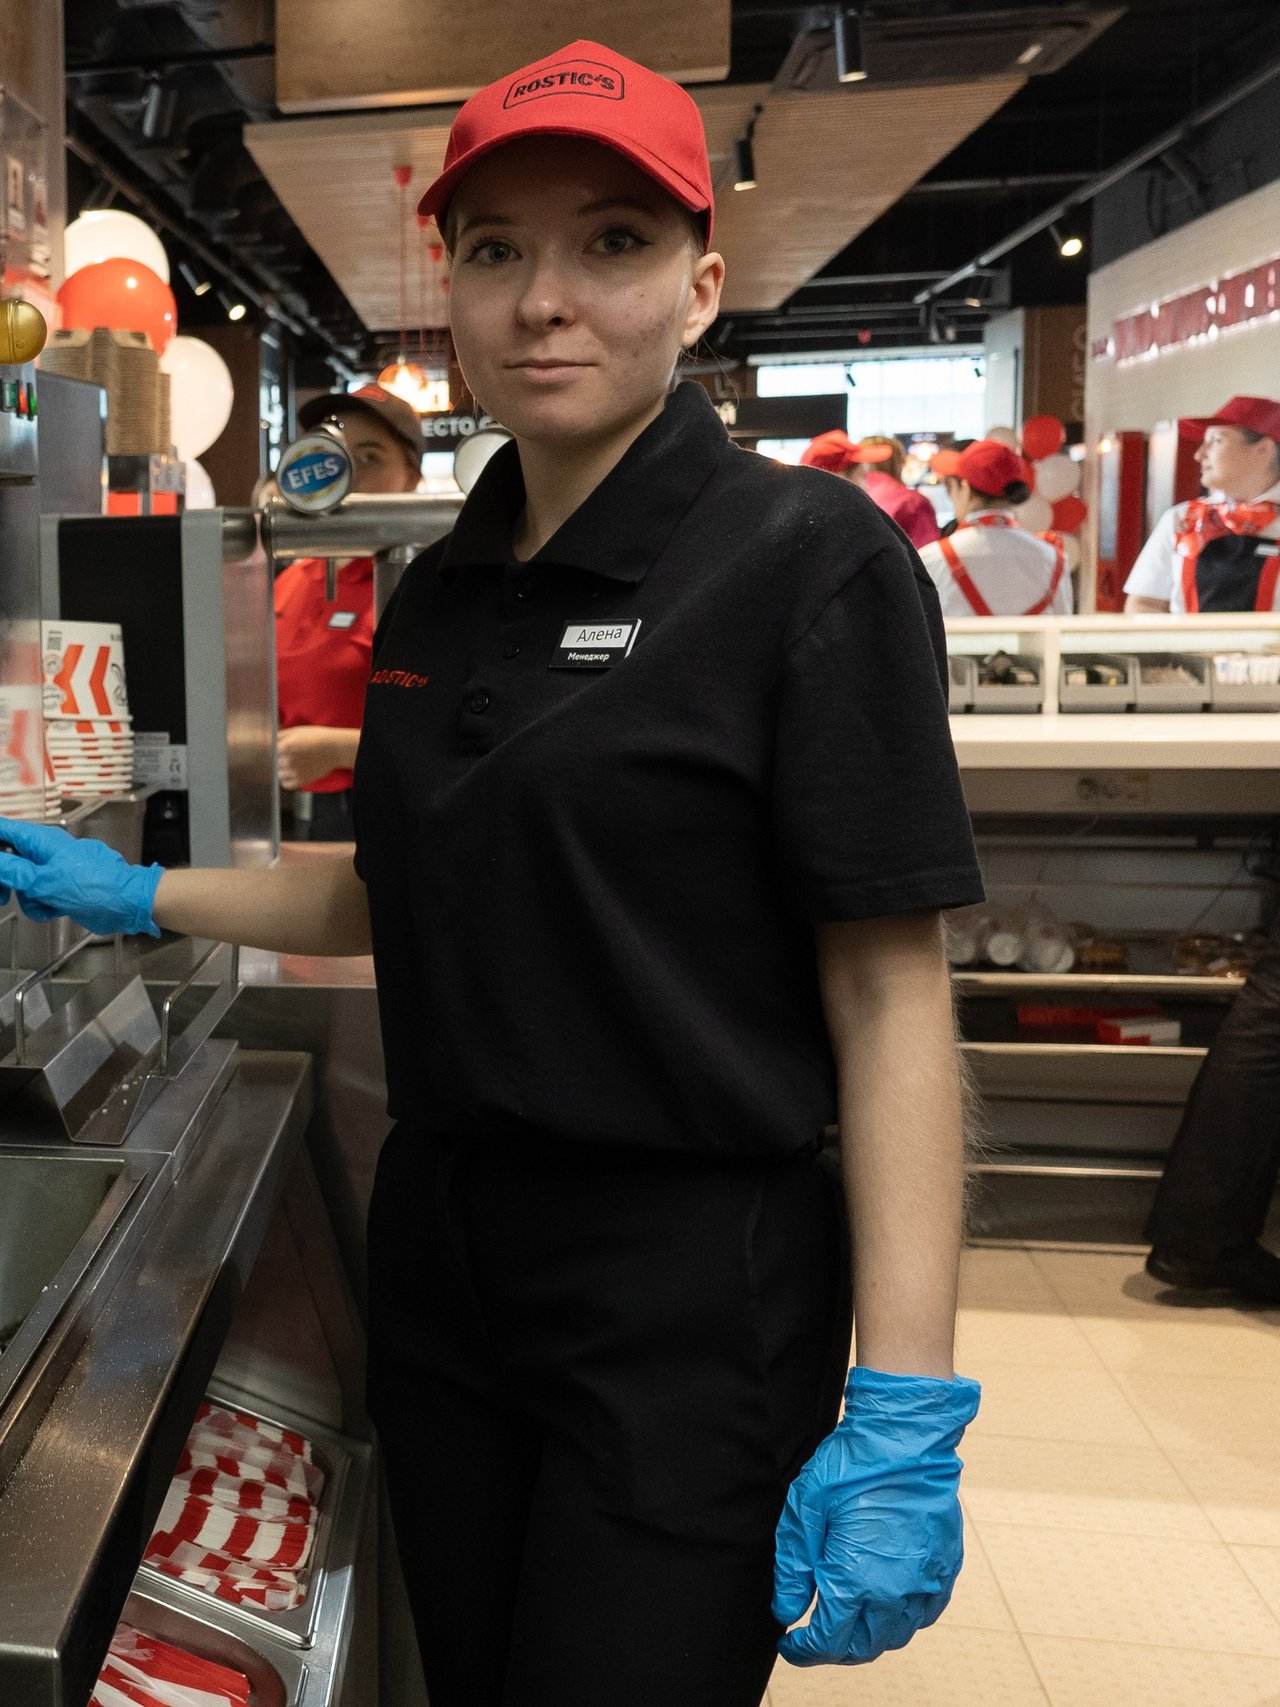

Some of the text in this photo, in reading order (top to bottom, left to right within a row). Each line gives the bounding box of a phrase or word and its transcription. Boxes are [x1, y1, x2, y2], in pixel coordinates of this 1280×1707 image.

[513, 71, 615, 99] ROSTIC'S
[420, 416, 477, 438] ЕСТО
[286, 457, 341, 491] EFES
[576, 628, 623, 643] Алена
[567, 652, 610, 662] Менеджер
